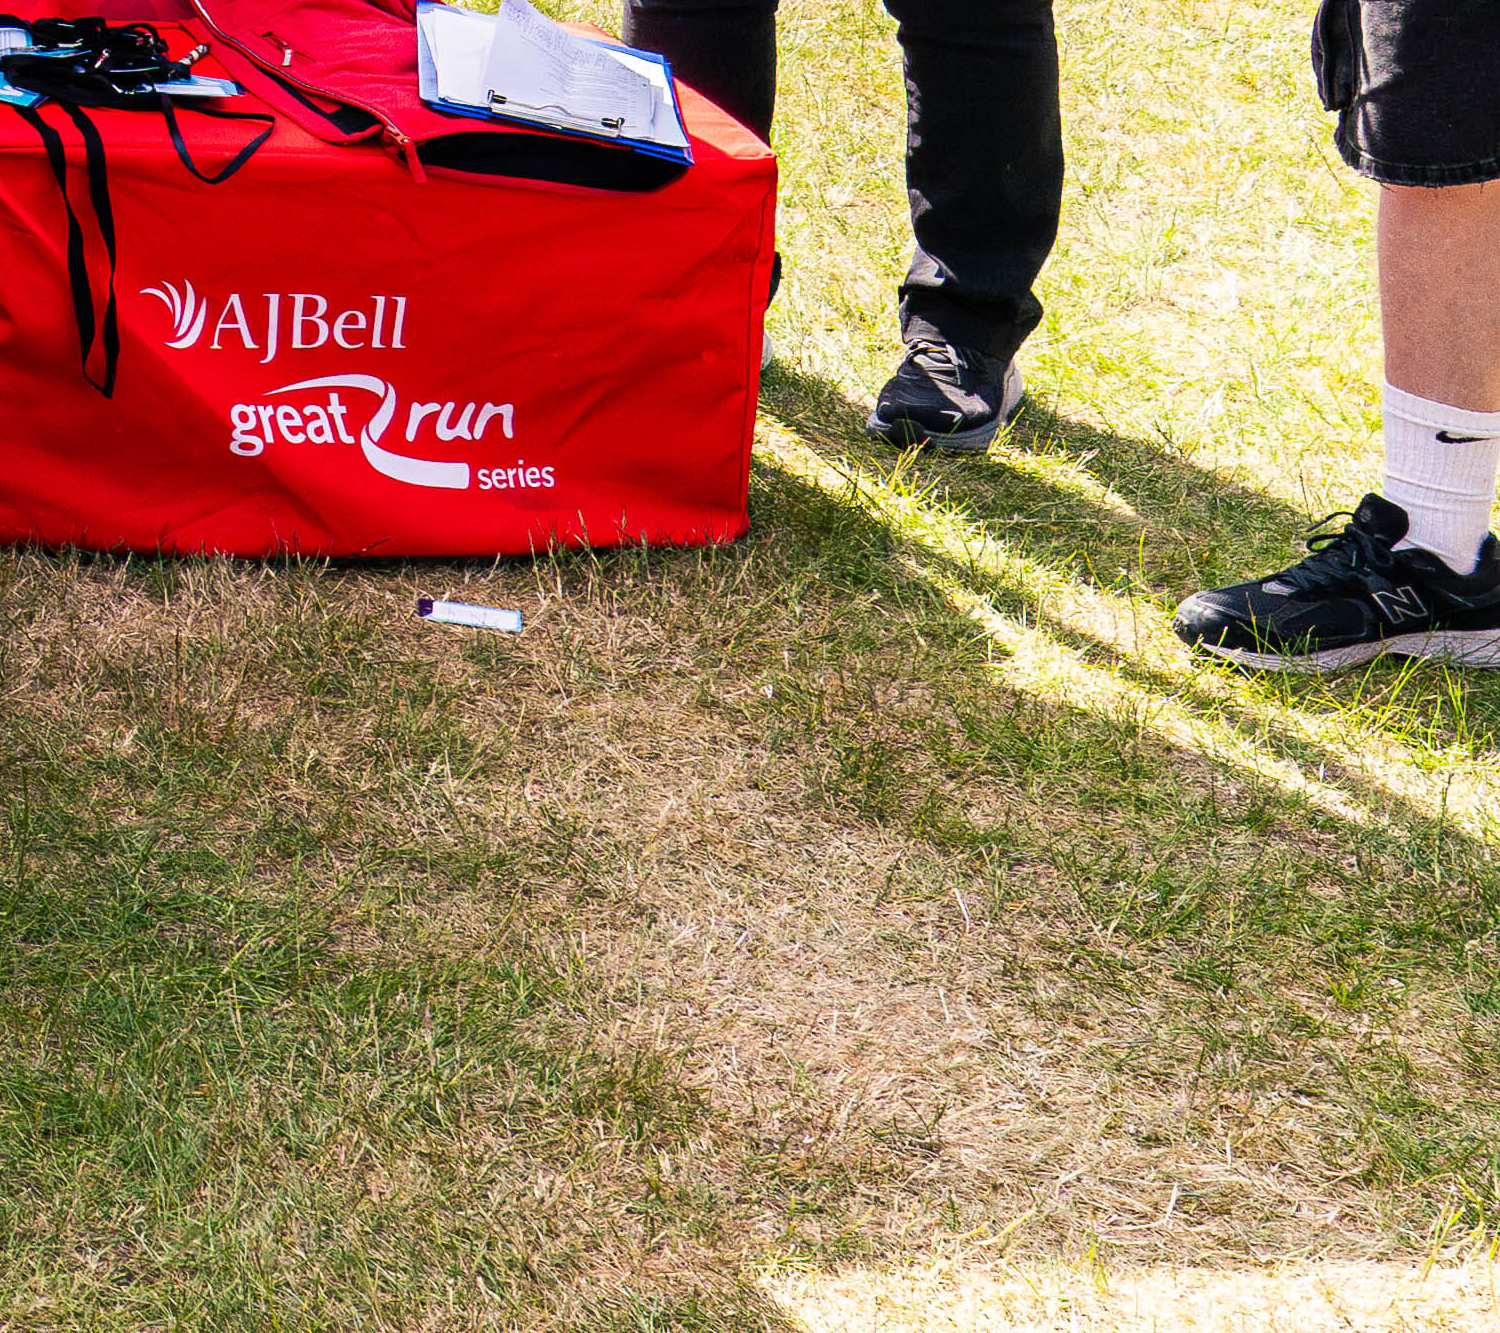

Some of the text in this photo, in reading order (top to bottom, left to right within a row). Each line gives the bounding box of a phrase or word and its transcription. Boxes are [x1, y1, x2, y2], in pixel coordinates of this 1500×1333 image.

[210, 293, 408, 365] AJBell
[229, 394, 516, 457] great run
[477, 458, 556, 491] series
